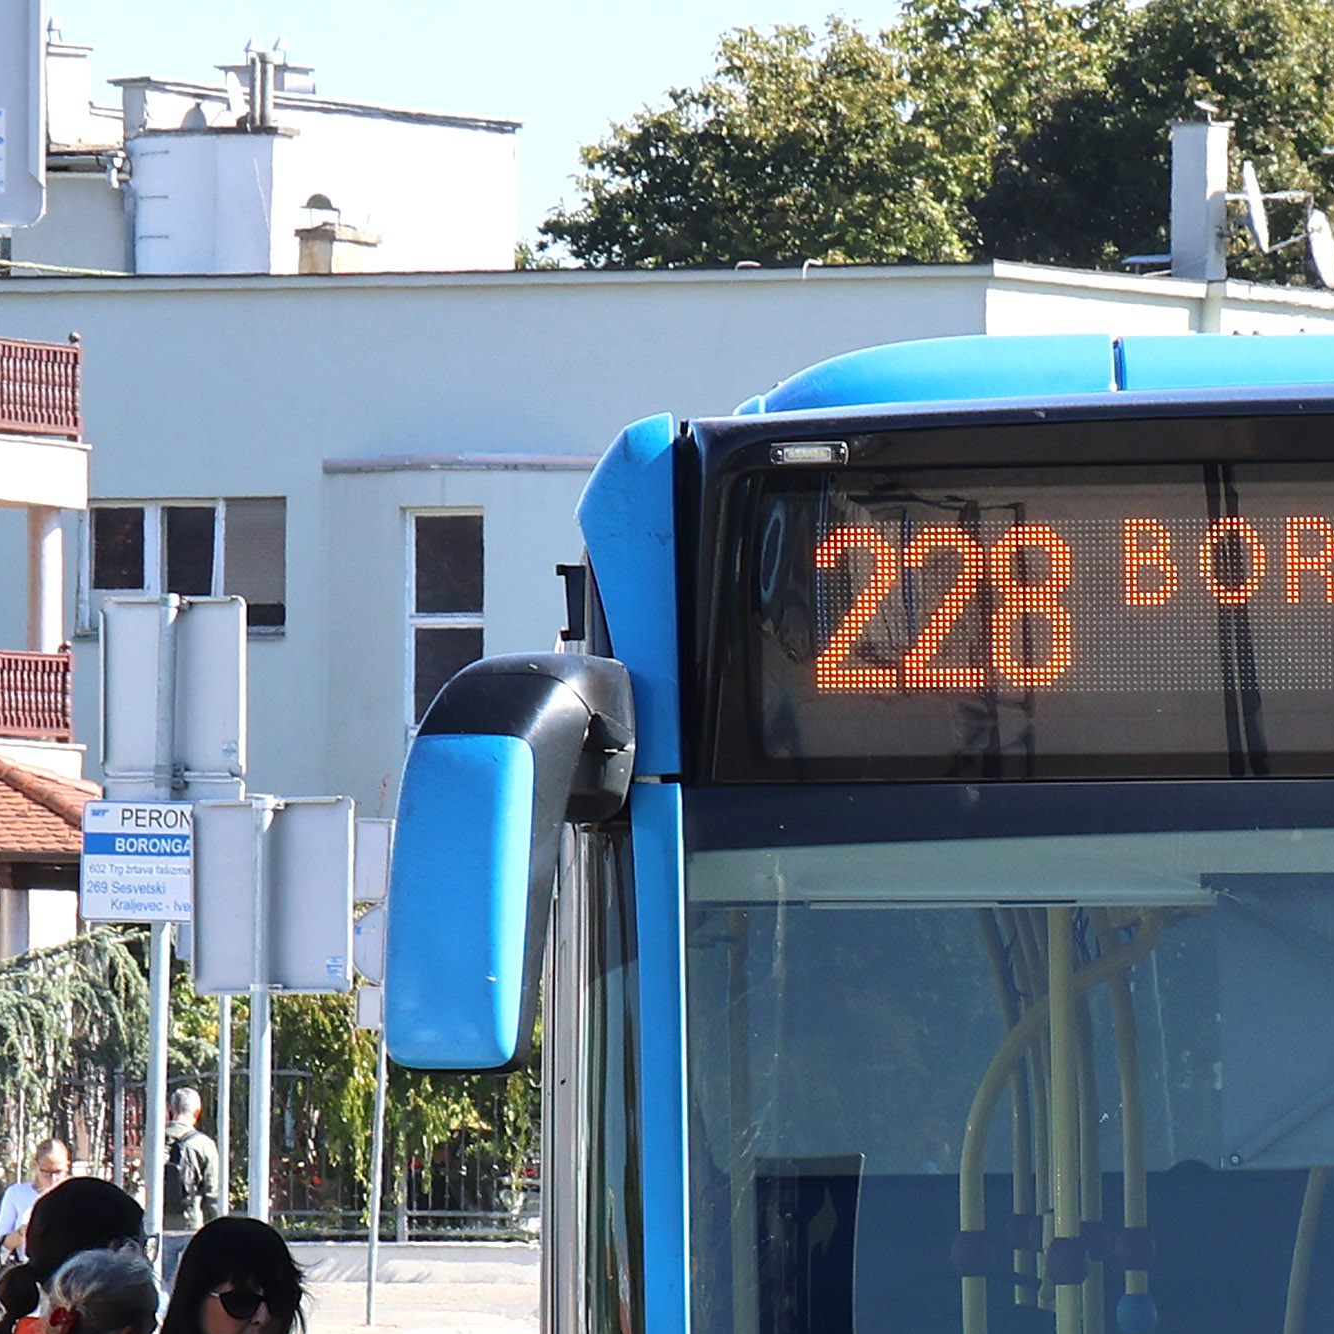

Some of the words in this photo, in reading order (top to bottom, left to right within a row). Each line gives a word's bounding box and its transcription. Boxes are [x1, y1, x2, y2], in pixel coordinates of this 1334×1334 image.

[814, 522, 1073, 690] 228
[120, 807, 191, 829] PERON
[87, 881, 108, 894] 269
[111, 881, 166, 895] Sesvetski
[110, 898, 164, 914] Kraljevec
